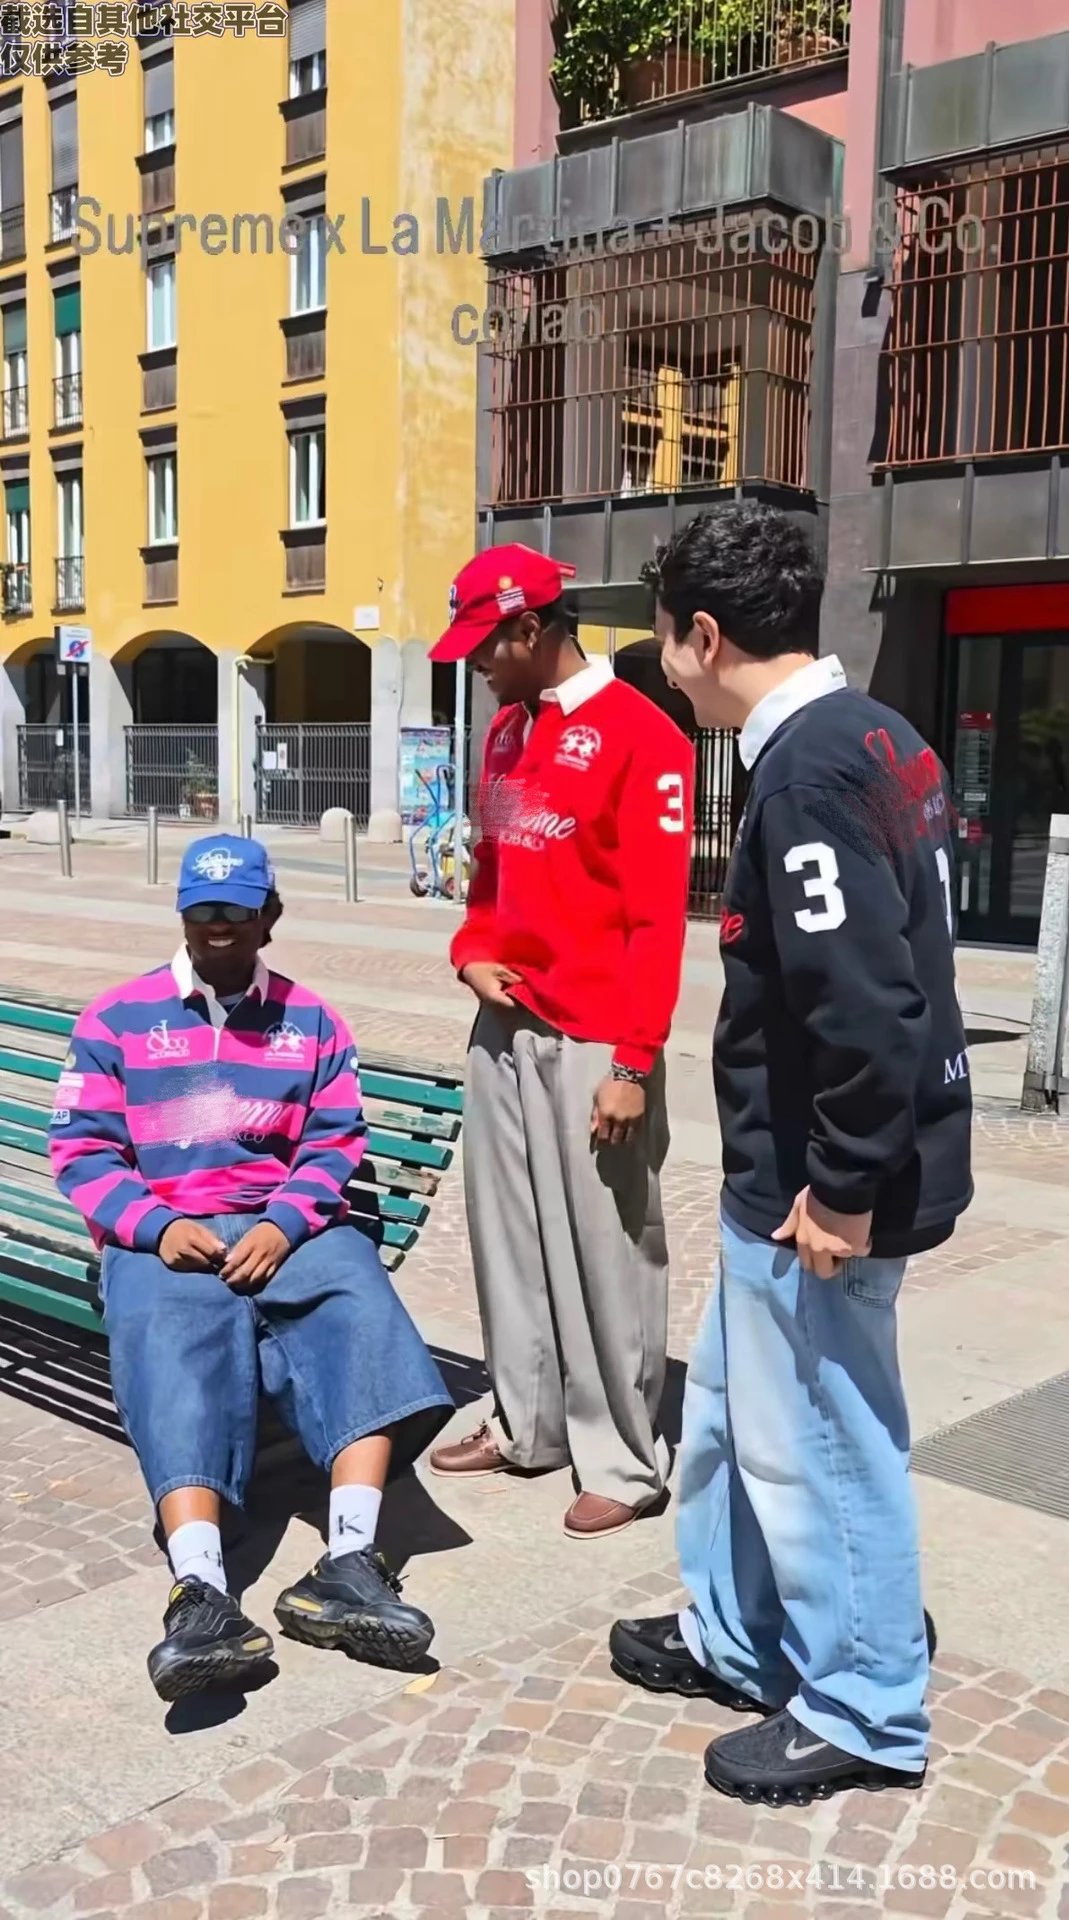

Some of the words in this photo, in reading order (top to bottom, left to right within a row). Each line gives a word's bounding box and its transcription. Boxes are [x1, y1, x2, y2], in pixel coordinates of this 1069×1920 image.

[657, 773, 684, 832] 3
[783, 841, 847, 933] 3
[944, 1051, 968, 1084] M
